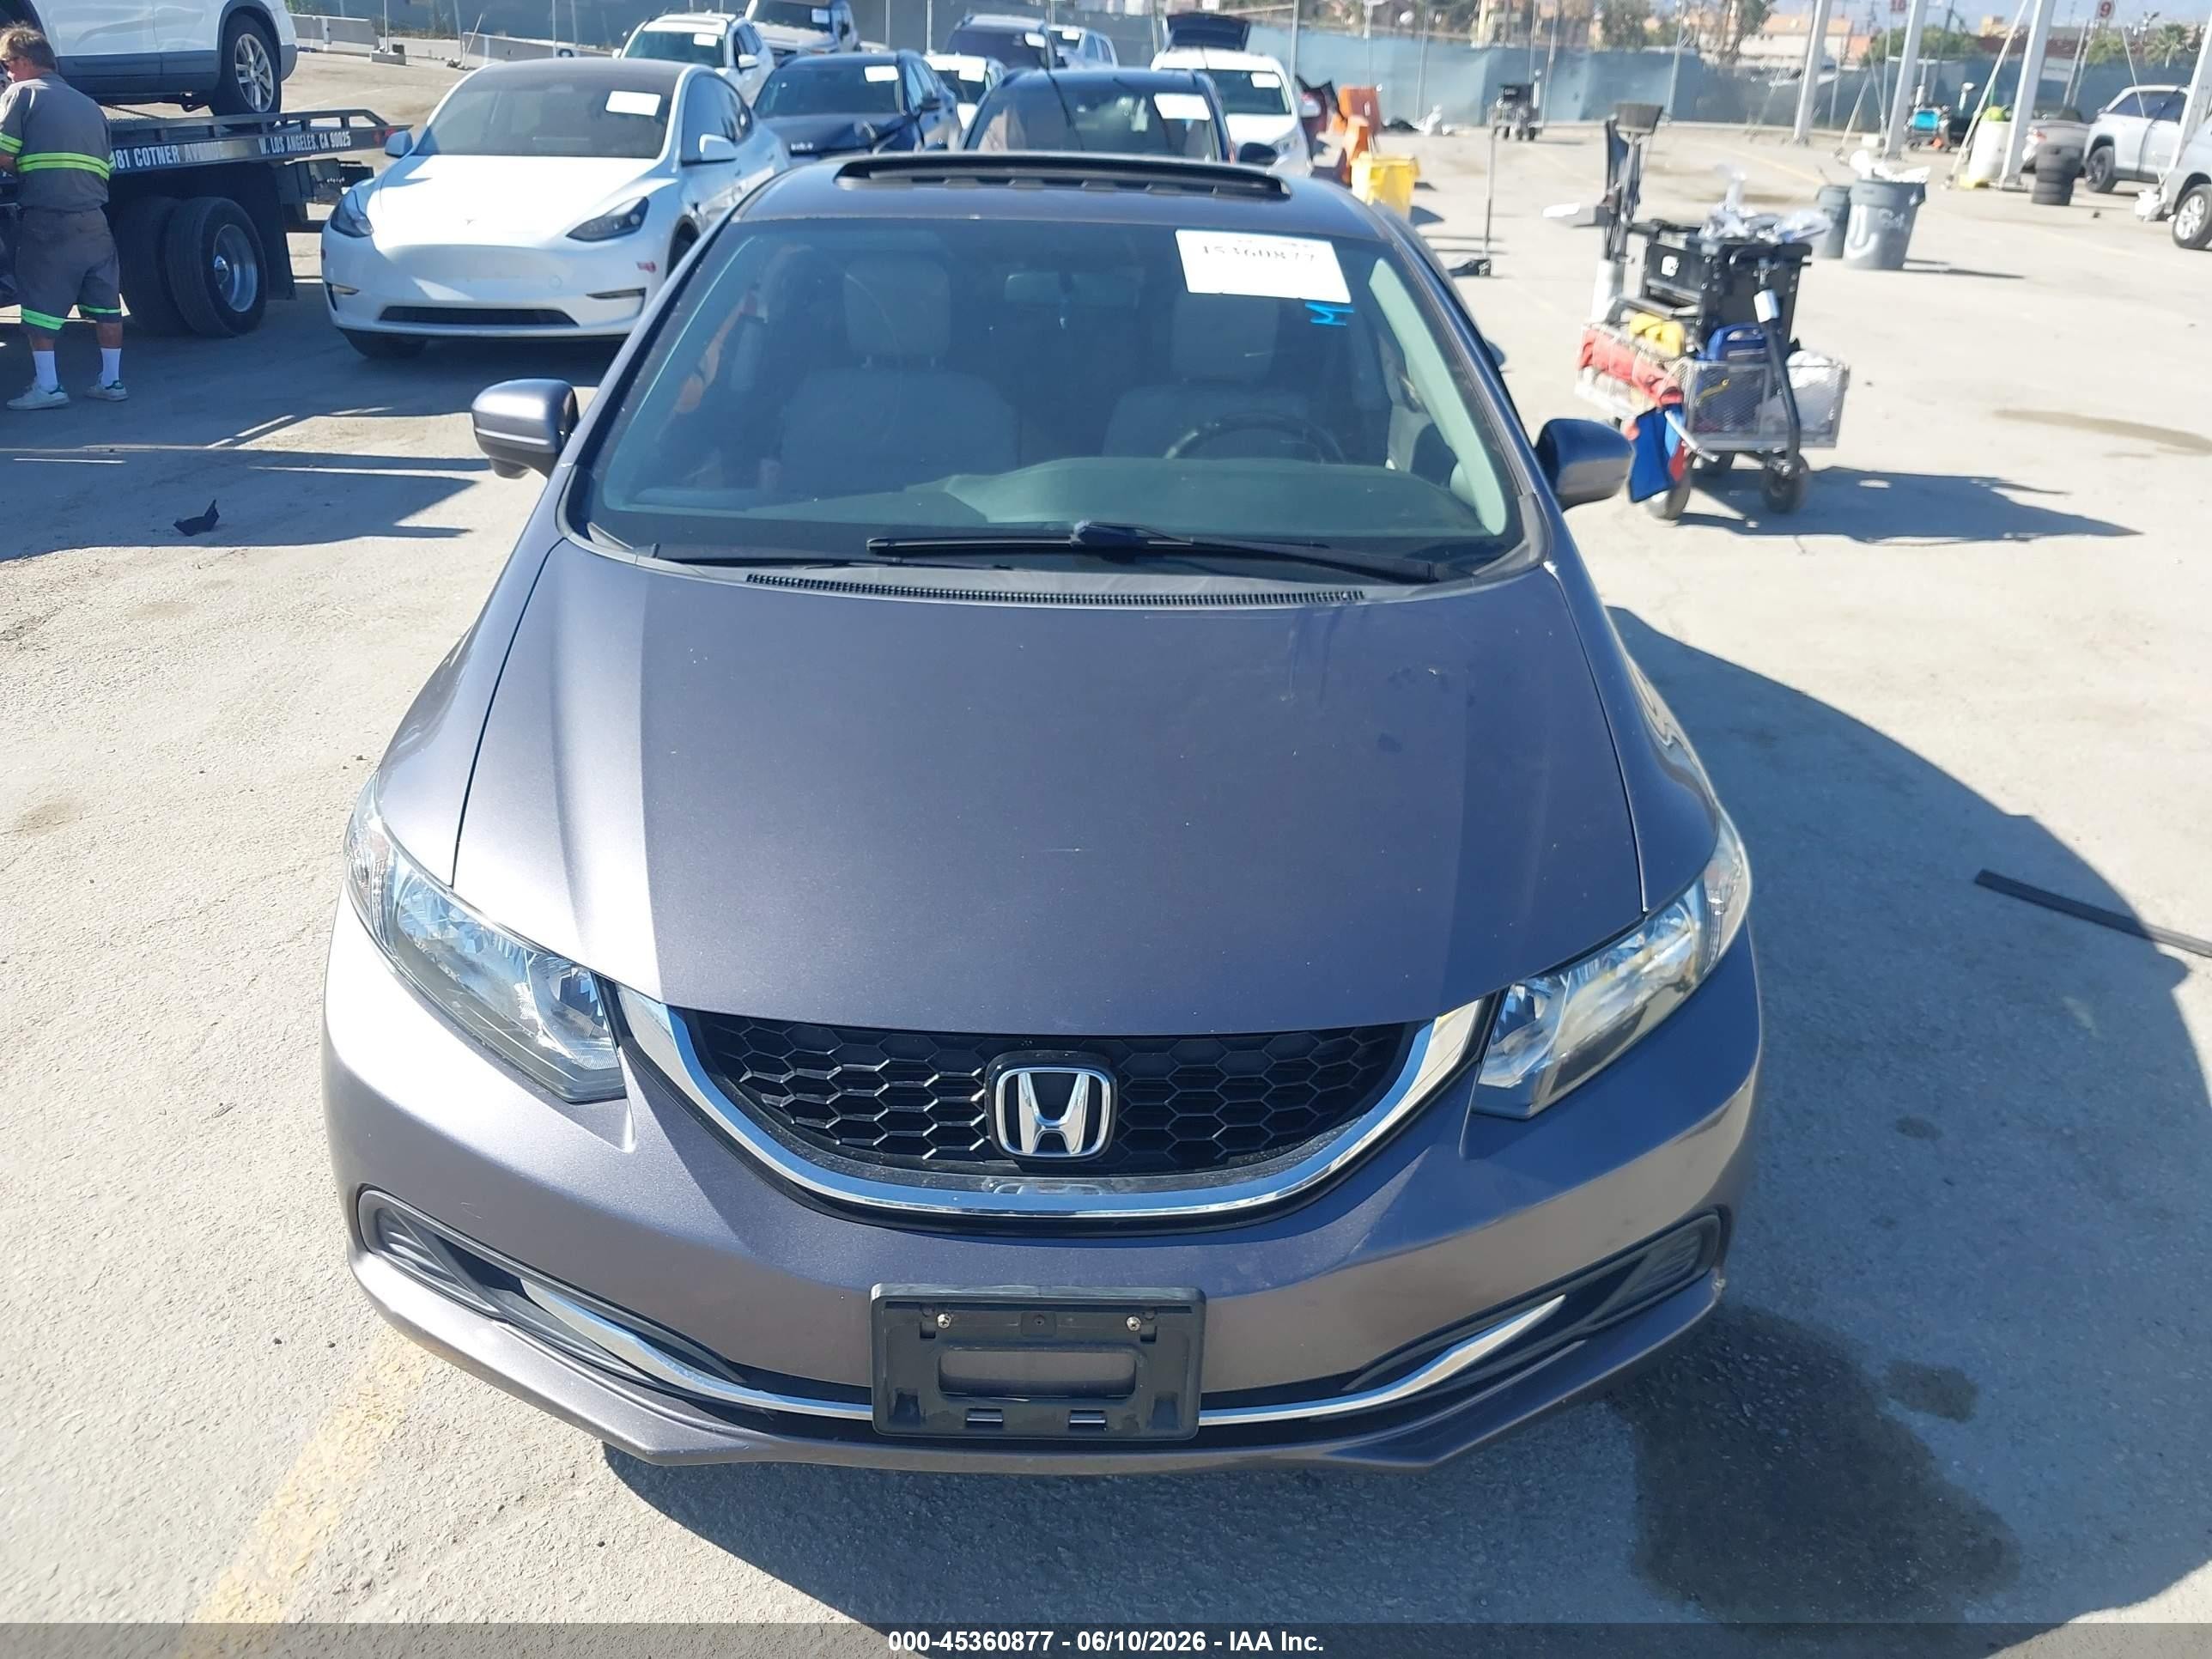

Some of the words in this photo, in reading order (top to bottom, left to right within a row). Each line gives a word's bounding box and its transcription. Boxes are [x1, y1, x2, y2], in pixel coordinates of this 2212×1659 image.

[134, 145, 180, 167] COTNER
[271, 136, 285, 154] LOS
[320, 132, 330, 149] CA
[330, 131, 351, 148] 90025
